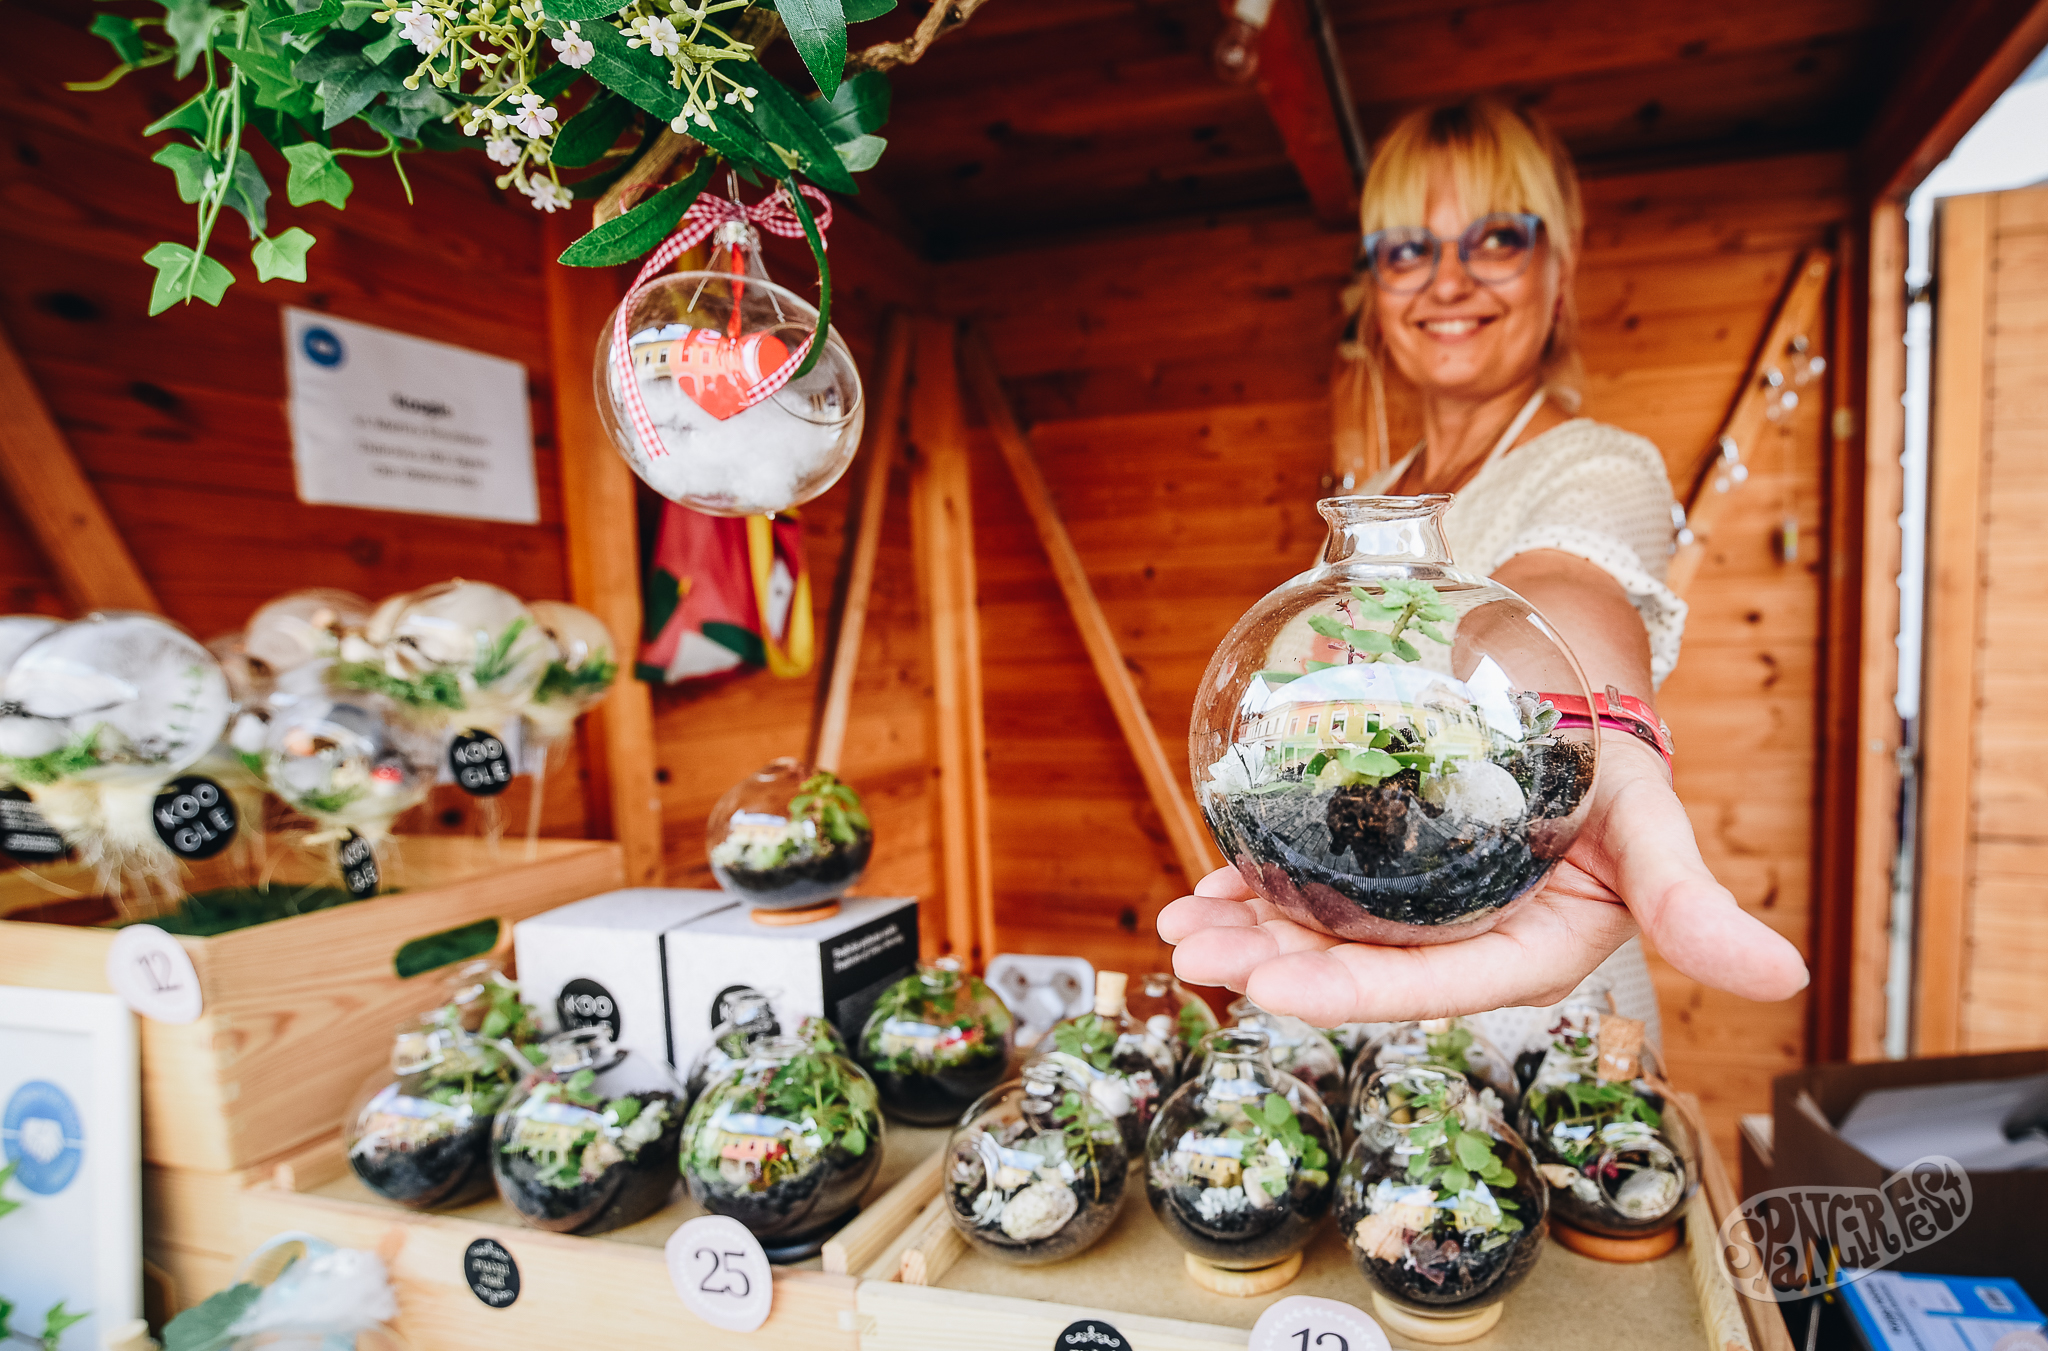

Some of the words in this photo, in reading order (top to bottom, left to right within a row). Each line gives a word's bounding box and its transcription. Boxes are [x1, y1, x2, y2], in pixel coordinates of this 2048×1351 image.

[453, 738, 503, 765] KOO
[155, 783, 219, 830] KOO
[174, 806, 235, 852] GLE
[136, 950, 183, 993] 12
[694, 1247, 750, 1298] 25
